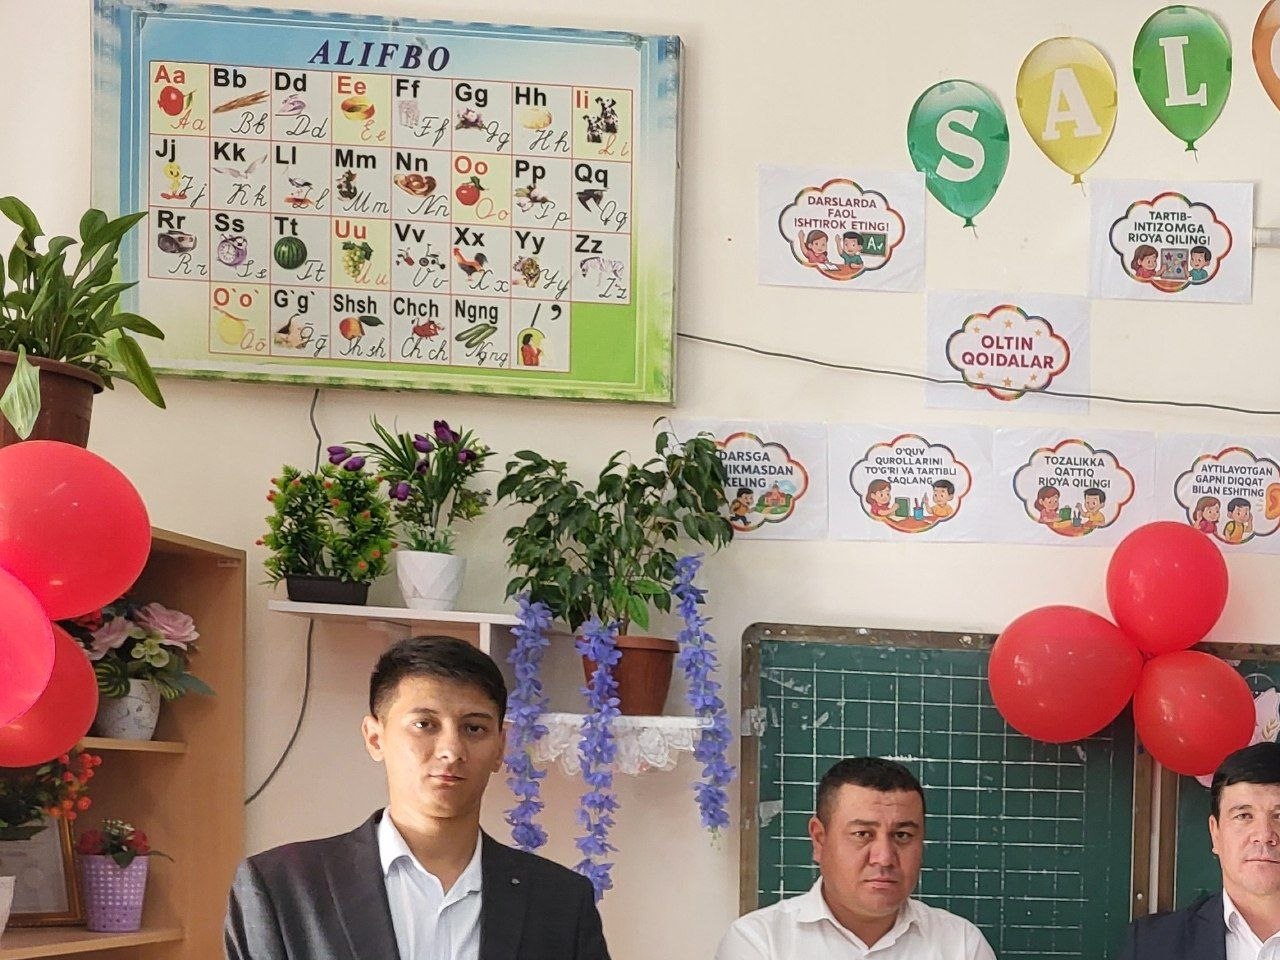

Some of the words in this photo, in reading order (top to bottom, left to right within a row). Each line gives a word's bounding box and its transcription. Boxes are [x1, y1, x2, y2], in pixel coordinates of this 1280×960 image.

[308, 39, 450, 72] ALIFBO
[155, 64, 185, 84] Aa
[214, 68, 247, 88] Bb
[275, 72, 307, 92] Dd
[337, 76, 367, 95] Ee
[396, 79, 420, 98] Ff
[455, 83, 488, 107] Gg
[515, 87, 547, 106] Hh
[576, 90, 589, 108] Ii
[155, 139, 176, 162] Jj
[214, 142, 246, 161] Kk
[276, 146, 296, 164] Ll
[335, 149, 376, 168] Mm
[396, 153, 428, 172] Nn
[455, 156, 488, 175] Oo
[515, 160, 546, 183] Pp
[575, 163, 608, 187] Qq
[808, 196, 877, 208] DARSLARDA
[828, 208, 857, 218] FAOL
[1149, 211, 1192, 221] TARTIB-
[794, 218, 846, 229] ISHTIROK
[851, 221, 889, 231] ETING!
[1134, 222, 1204, 233] INTIZOMGA
[158, 210, 185, 229] Rr
[215, 213, 245, 232] Ss
[274, 217, 298, 236] Tt
[335, 220, 366, 239] Uu
[395, 223, 425, 243] Vv
[454, 227, 485, 247] Xx
[515, 231, 545, 254] Yy
[575, 234, 603, 254] Zz
[1128, 233, 1162, 243] RIOYA
[333, 294, 377, 314] Shsh
[394, 297, 438, 318] Chch
[455, 299, 499, 324] Ngng
[981, 335, 1033, 350] OLTIN
[962, 352, 1054, 369] QOIDALAR
[720, 451, 771, 462] DARSGA
[875, 456, 943, 465] QUROLLARINI
[1044, 456, 1105, 467] TOZALIKKA
[901, 467, 914, 475] VA
[916, 467, 957, 475] TARTIBLI
[1054, 467, 1094, 478] QATTIQ
[1201, 464, 1273, 476] AYTILAYOTGAN
[724, 477, 766, 487] KELING
[887, 476, 933, 485] SAQLANG
[1038, 477, 1069, 486] RIOYA
[1195, 475, 1225, 484] GAPNI
[1227, 476, 1263, 486] DIQQAT
[1192, 485, 1220, 495] BILAN
[1222, 487, 1264, 497] ESHITING
